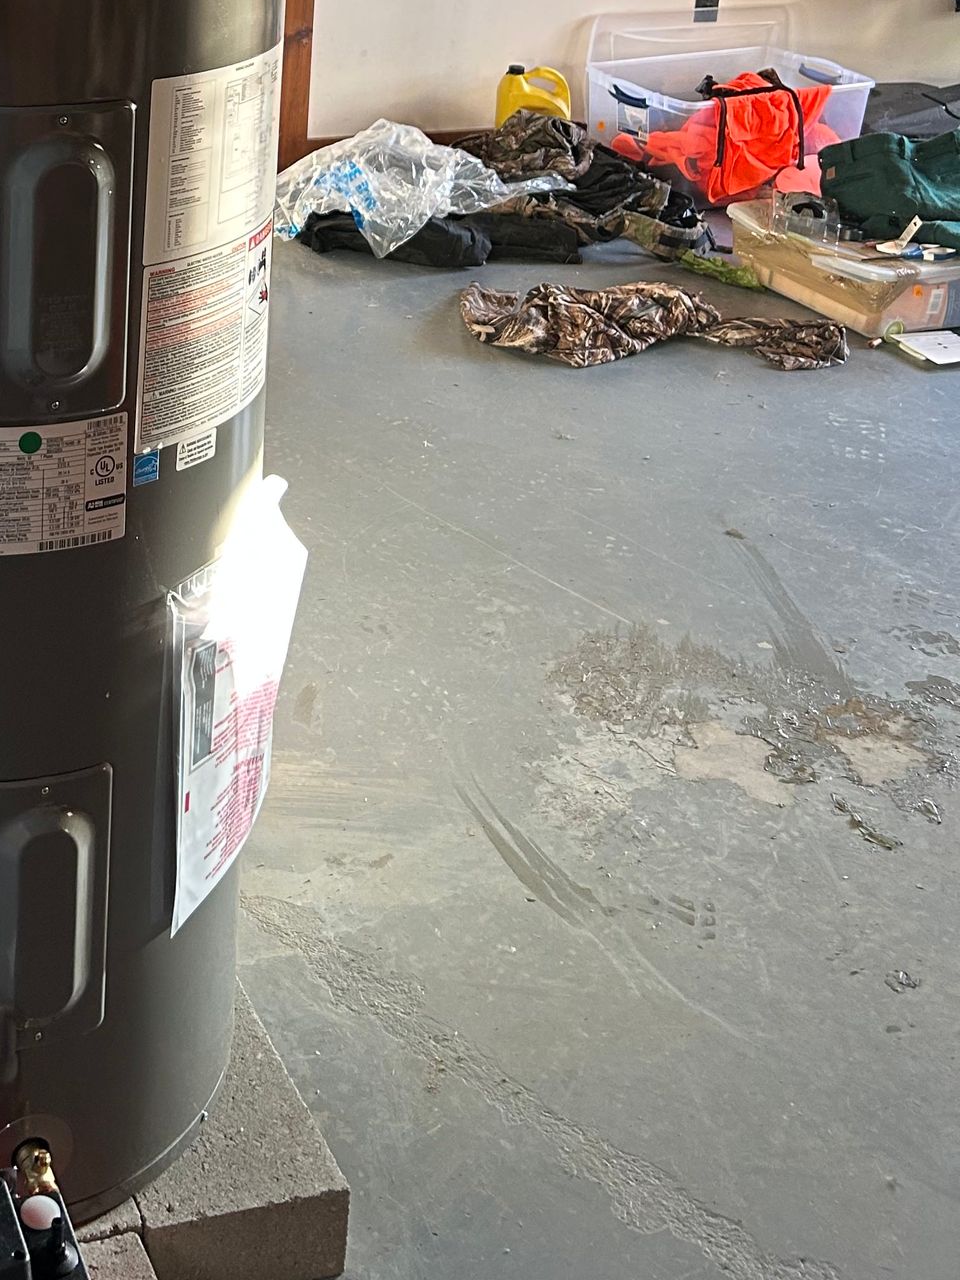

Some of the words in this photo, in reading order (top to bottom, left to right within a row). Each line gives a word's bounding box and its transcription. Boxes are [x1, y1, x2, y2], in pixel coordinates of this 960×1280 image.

[150, 267, 176, 276] WARNING
[100, 460, 110, 472] UL
[95, 477, 115, 486] LISTED
